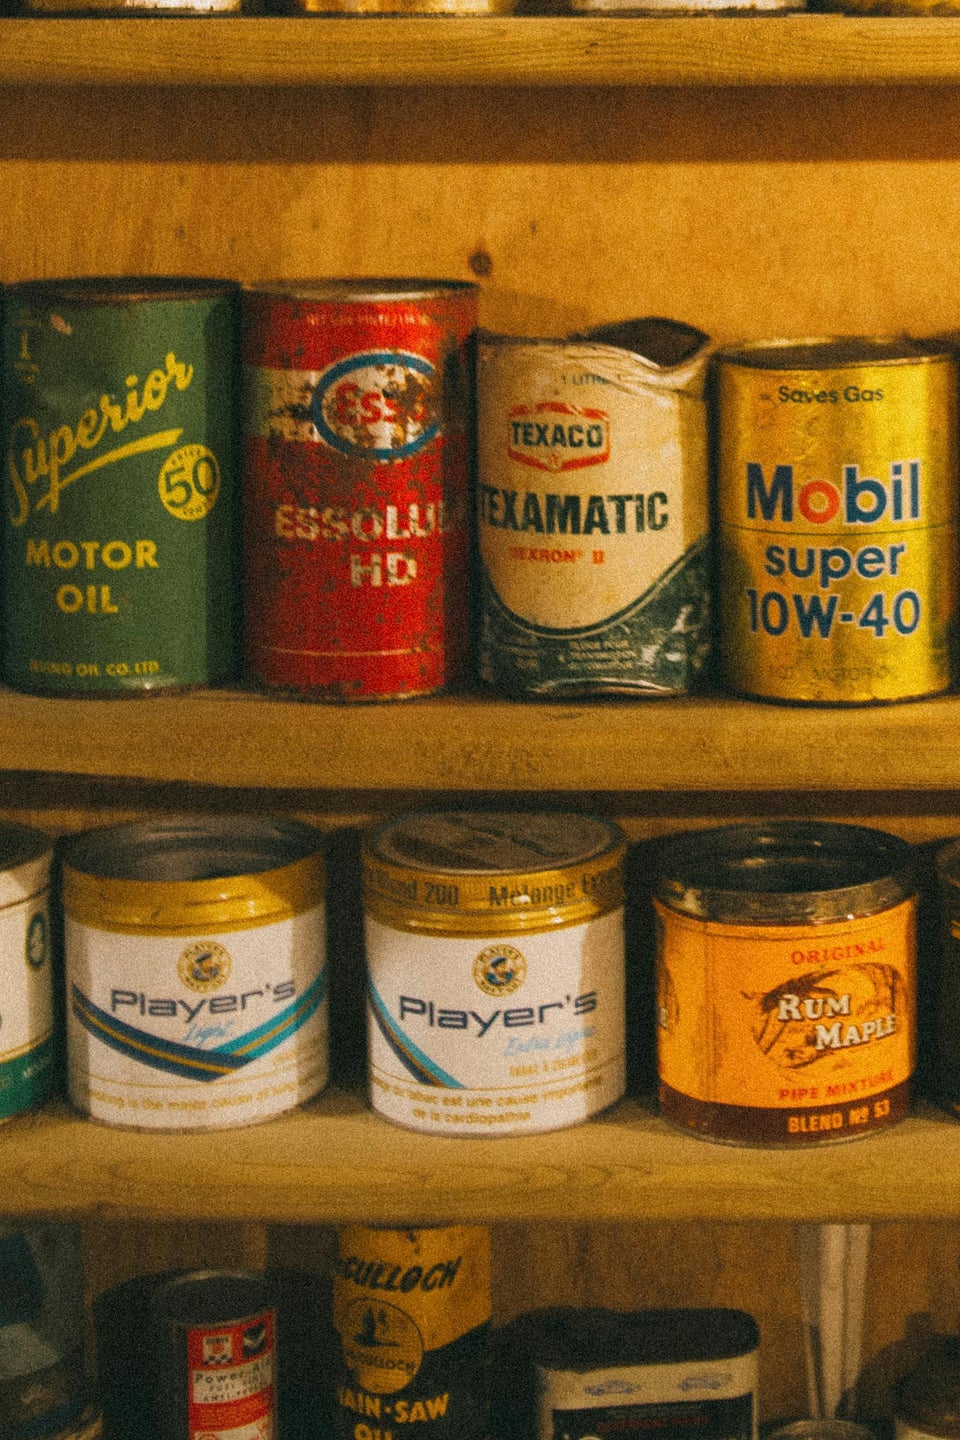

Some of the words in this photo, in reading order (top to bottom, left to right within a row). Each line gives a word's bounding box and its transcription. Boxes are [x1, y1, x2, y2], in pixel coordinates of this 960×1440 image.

[777, 385, 839, 405] Saves
[843, 385, 885, 404] Gas
[6, 351, 195, 527] Superior
[510, 420, 604, 449] TEXACO
[163, 454, 219, 509] 50
[746, 461, 922, 526] Mobil
[478, 483, 670, 536] TEXAMATIC
[25, 538, 160, 571] MOTOR
[349, 553, 417, 588] HD
[764, 543, 908, 589] super
[55, 583, 120, 614] OIL
[747, 589, 922, 640] 10W-40
[424, 882, 460, 907] 200
[790, 936, 887, 966] ORIGINAL
[110, 979, 297, 1023] Player's
[399, 990, 598, 1039] Player's
[776, 993, 851, 1022] RUM
[815, 1013, 897, 1051] MAPLE
[777, 1086, 819, 1102] PIPE
